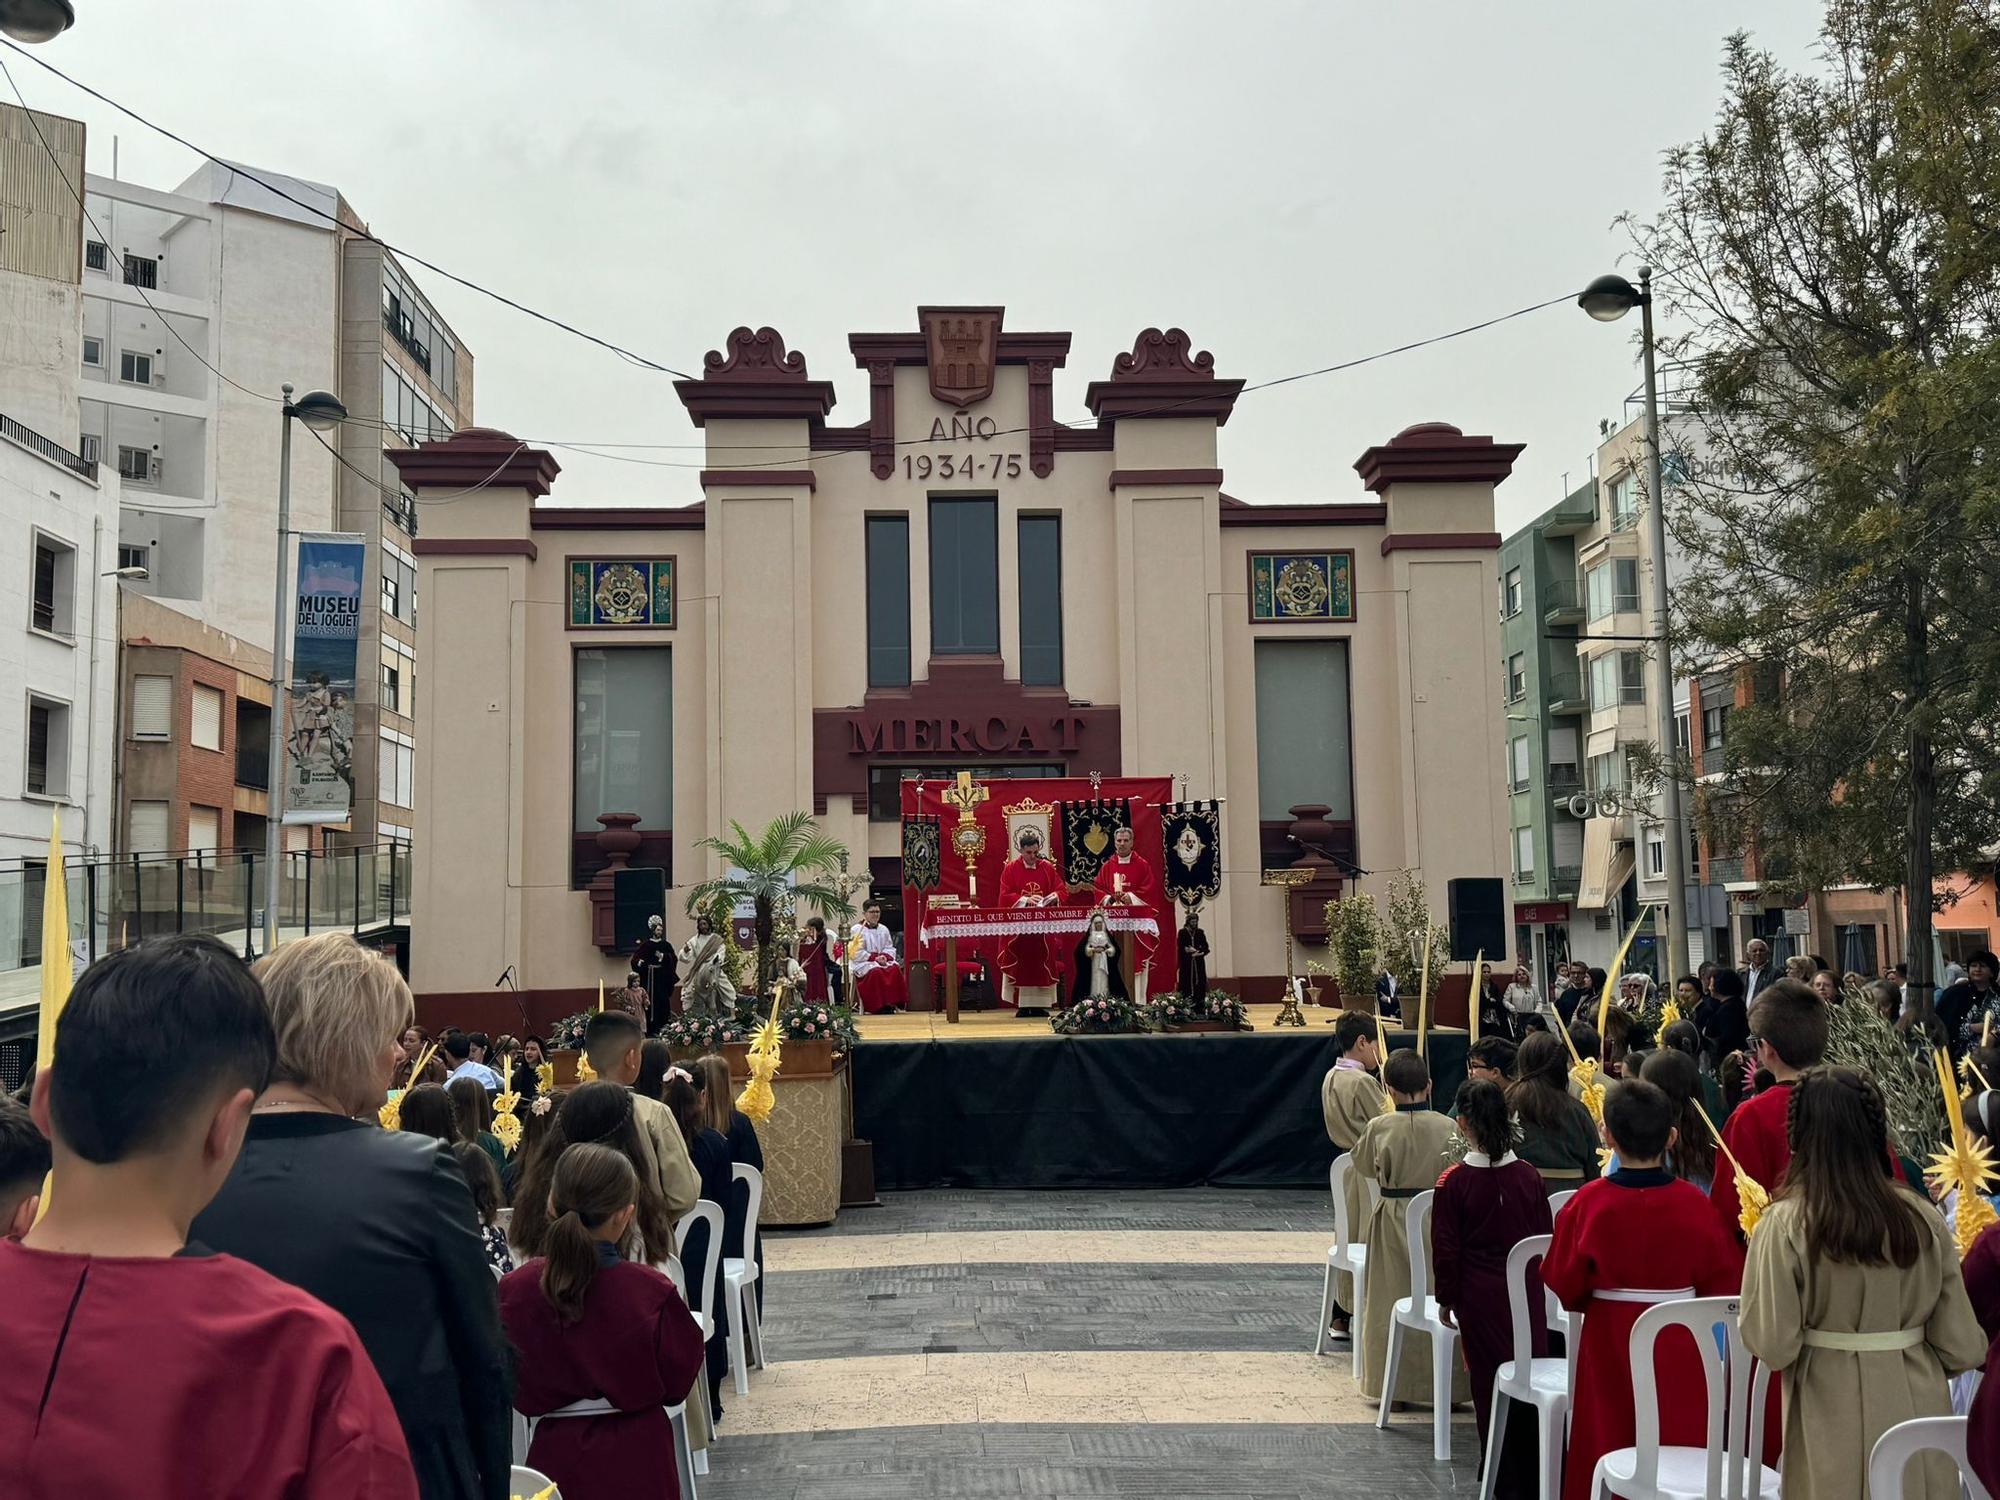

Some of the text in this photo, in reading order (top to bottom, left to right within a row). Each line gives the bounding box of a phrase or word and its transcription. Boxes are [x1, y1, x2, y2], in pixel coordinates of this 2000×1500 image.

[930, 410, 997, 441] AÑO
[903, 454, 1022, 480] 1934-75
[298, 595, 359, 613] MUSEU
[298, 613, 358, 627] DEL JOGUET
[847, 717, 1086, 754] MERCAT
[936, 914, 972, 924] BENDITO
[974, 914, 985, 922] EL
[987, 913, 1005, 922] QUE
[1006, 912, 1033, 921] VIENE
[1035, 911, 1046, 919] EN
[1049, 909, 1083, 919] NOMBRE
